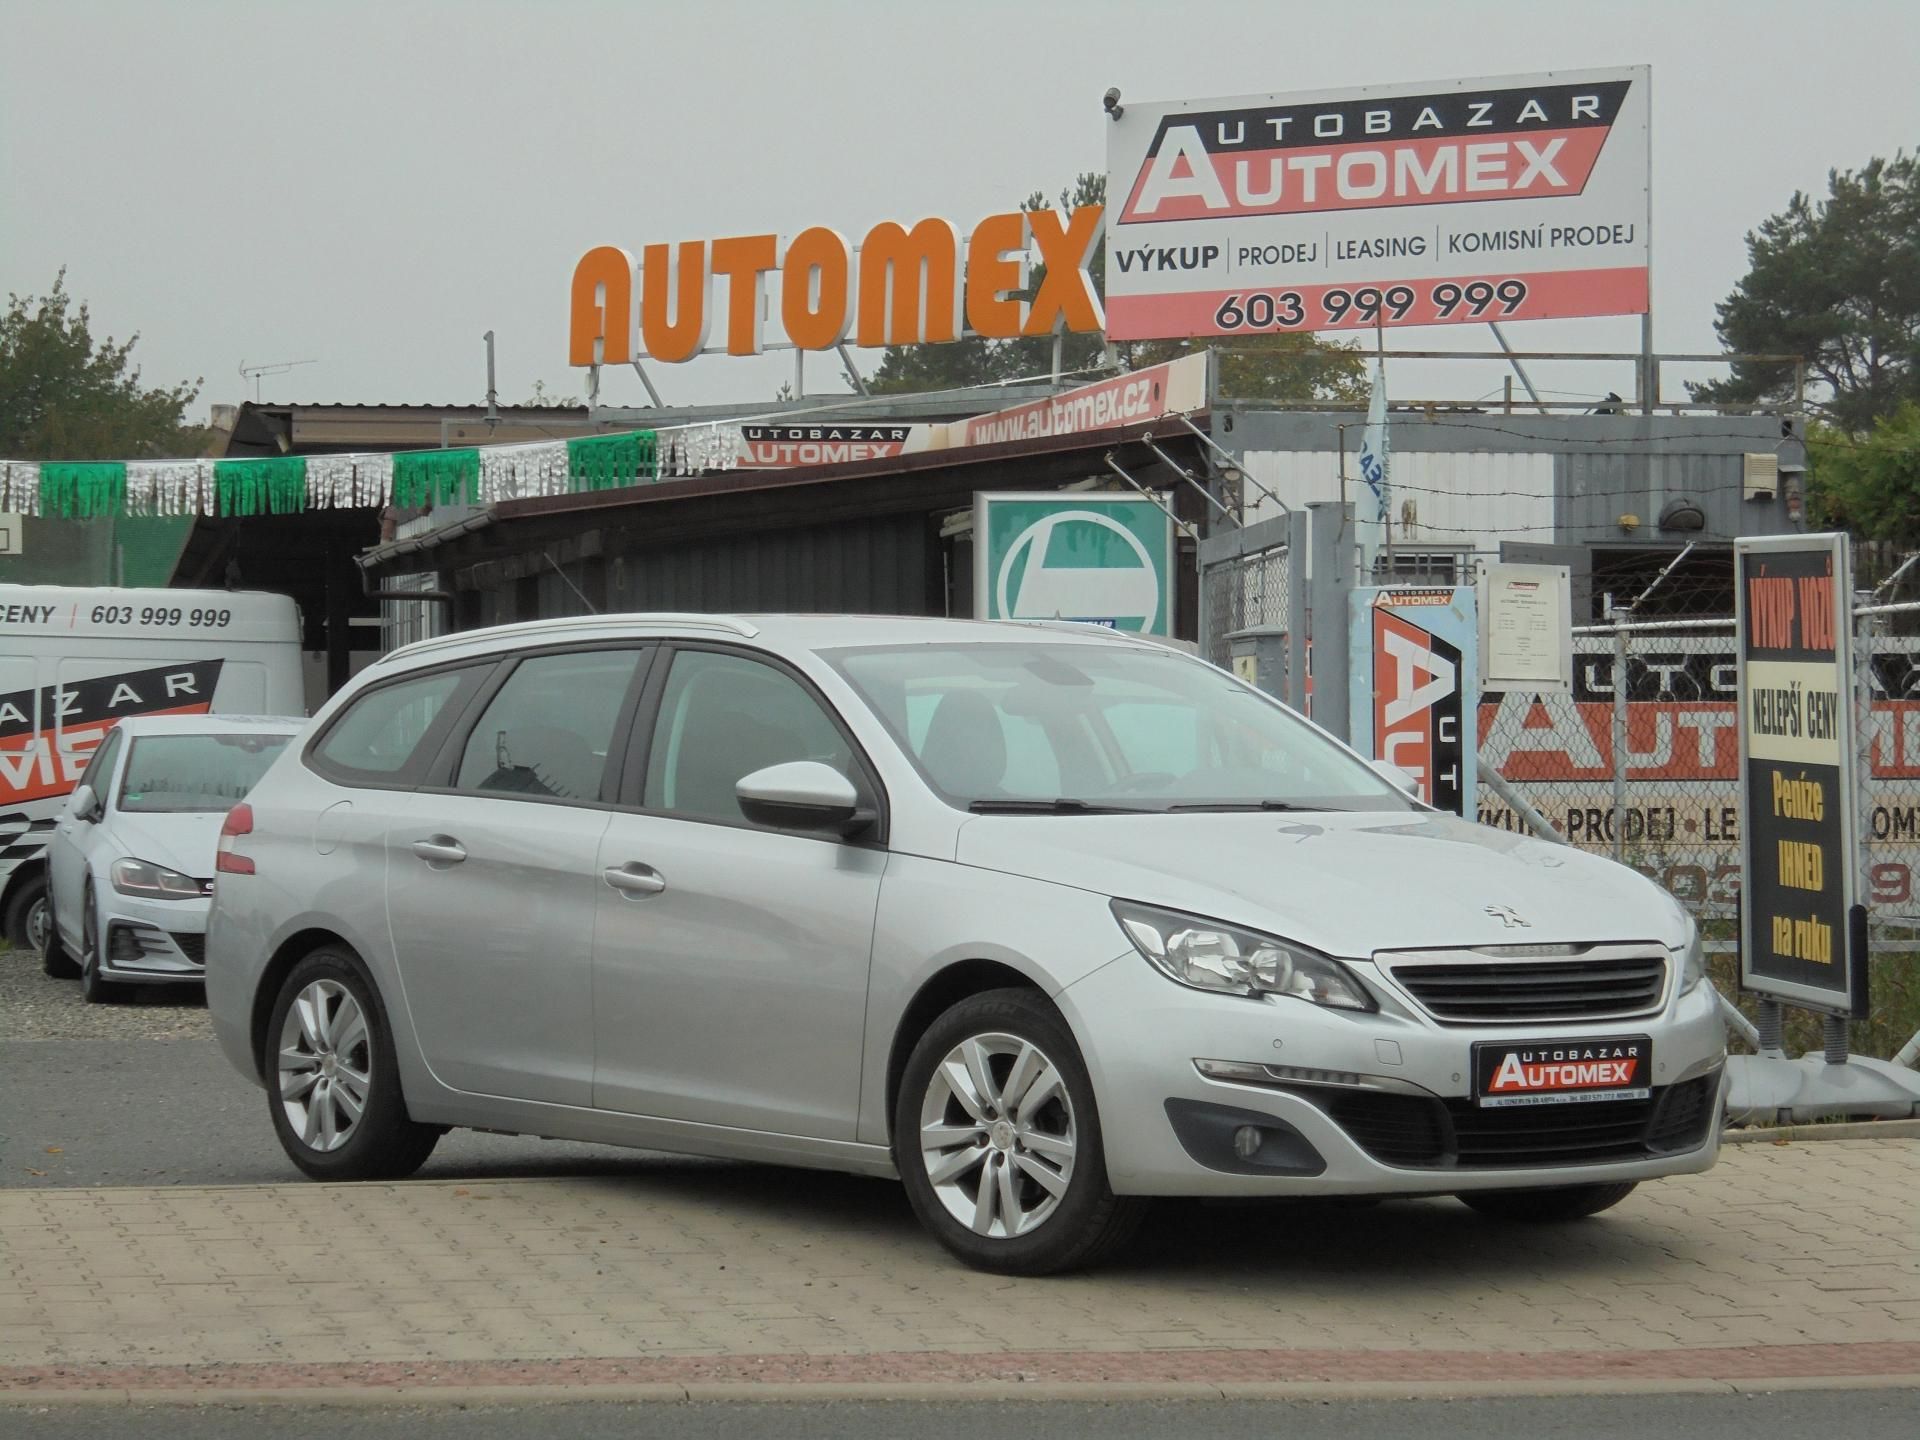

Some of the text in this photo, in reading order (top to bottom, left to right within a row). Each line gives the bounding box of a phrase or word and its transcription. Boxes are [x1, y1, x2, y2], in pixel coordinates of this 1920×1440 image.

[1131, 124, 1569, 215] AUTOMEX
[1115, 222, 1635, 273] VÝKUP PRODEJ LEASING KOMISNÍ PRODEJ
[568, 204, 1104, 367] AUTOMEX
[1214, 279, 1528, 331] 603 999 999
[91, 605, 133, 625] 603
[140, 607, 182, 626] 999
[189, 608, 231, 628] 999
[1375, 591, 1449, 606] AUTOMEX
[1749, 563, 1795, 649] VÝKUP
[1752, 680, 1802, 738] NEJLEPŠÍ
[1807, 690, 1838, 740] CENY
[1772, 770, 1824, 822] Peníze
[1778, 839, 1824, 892] IHNED
[1772, 914, 1832, 965] na ruku
[1494, 1052, 1630, 1088] AUTOMEX
